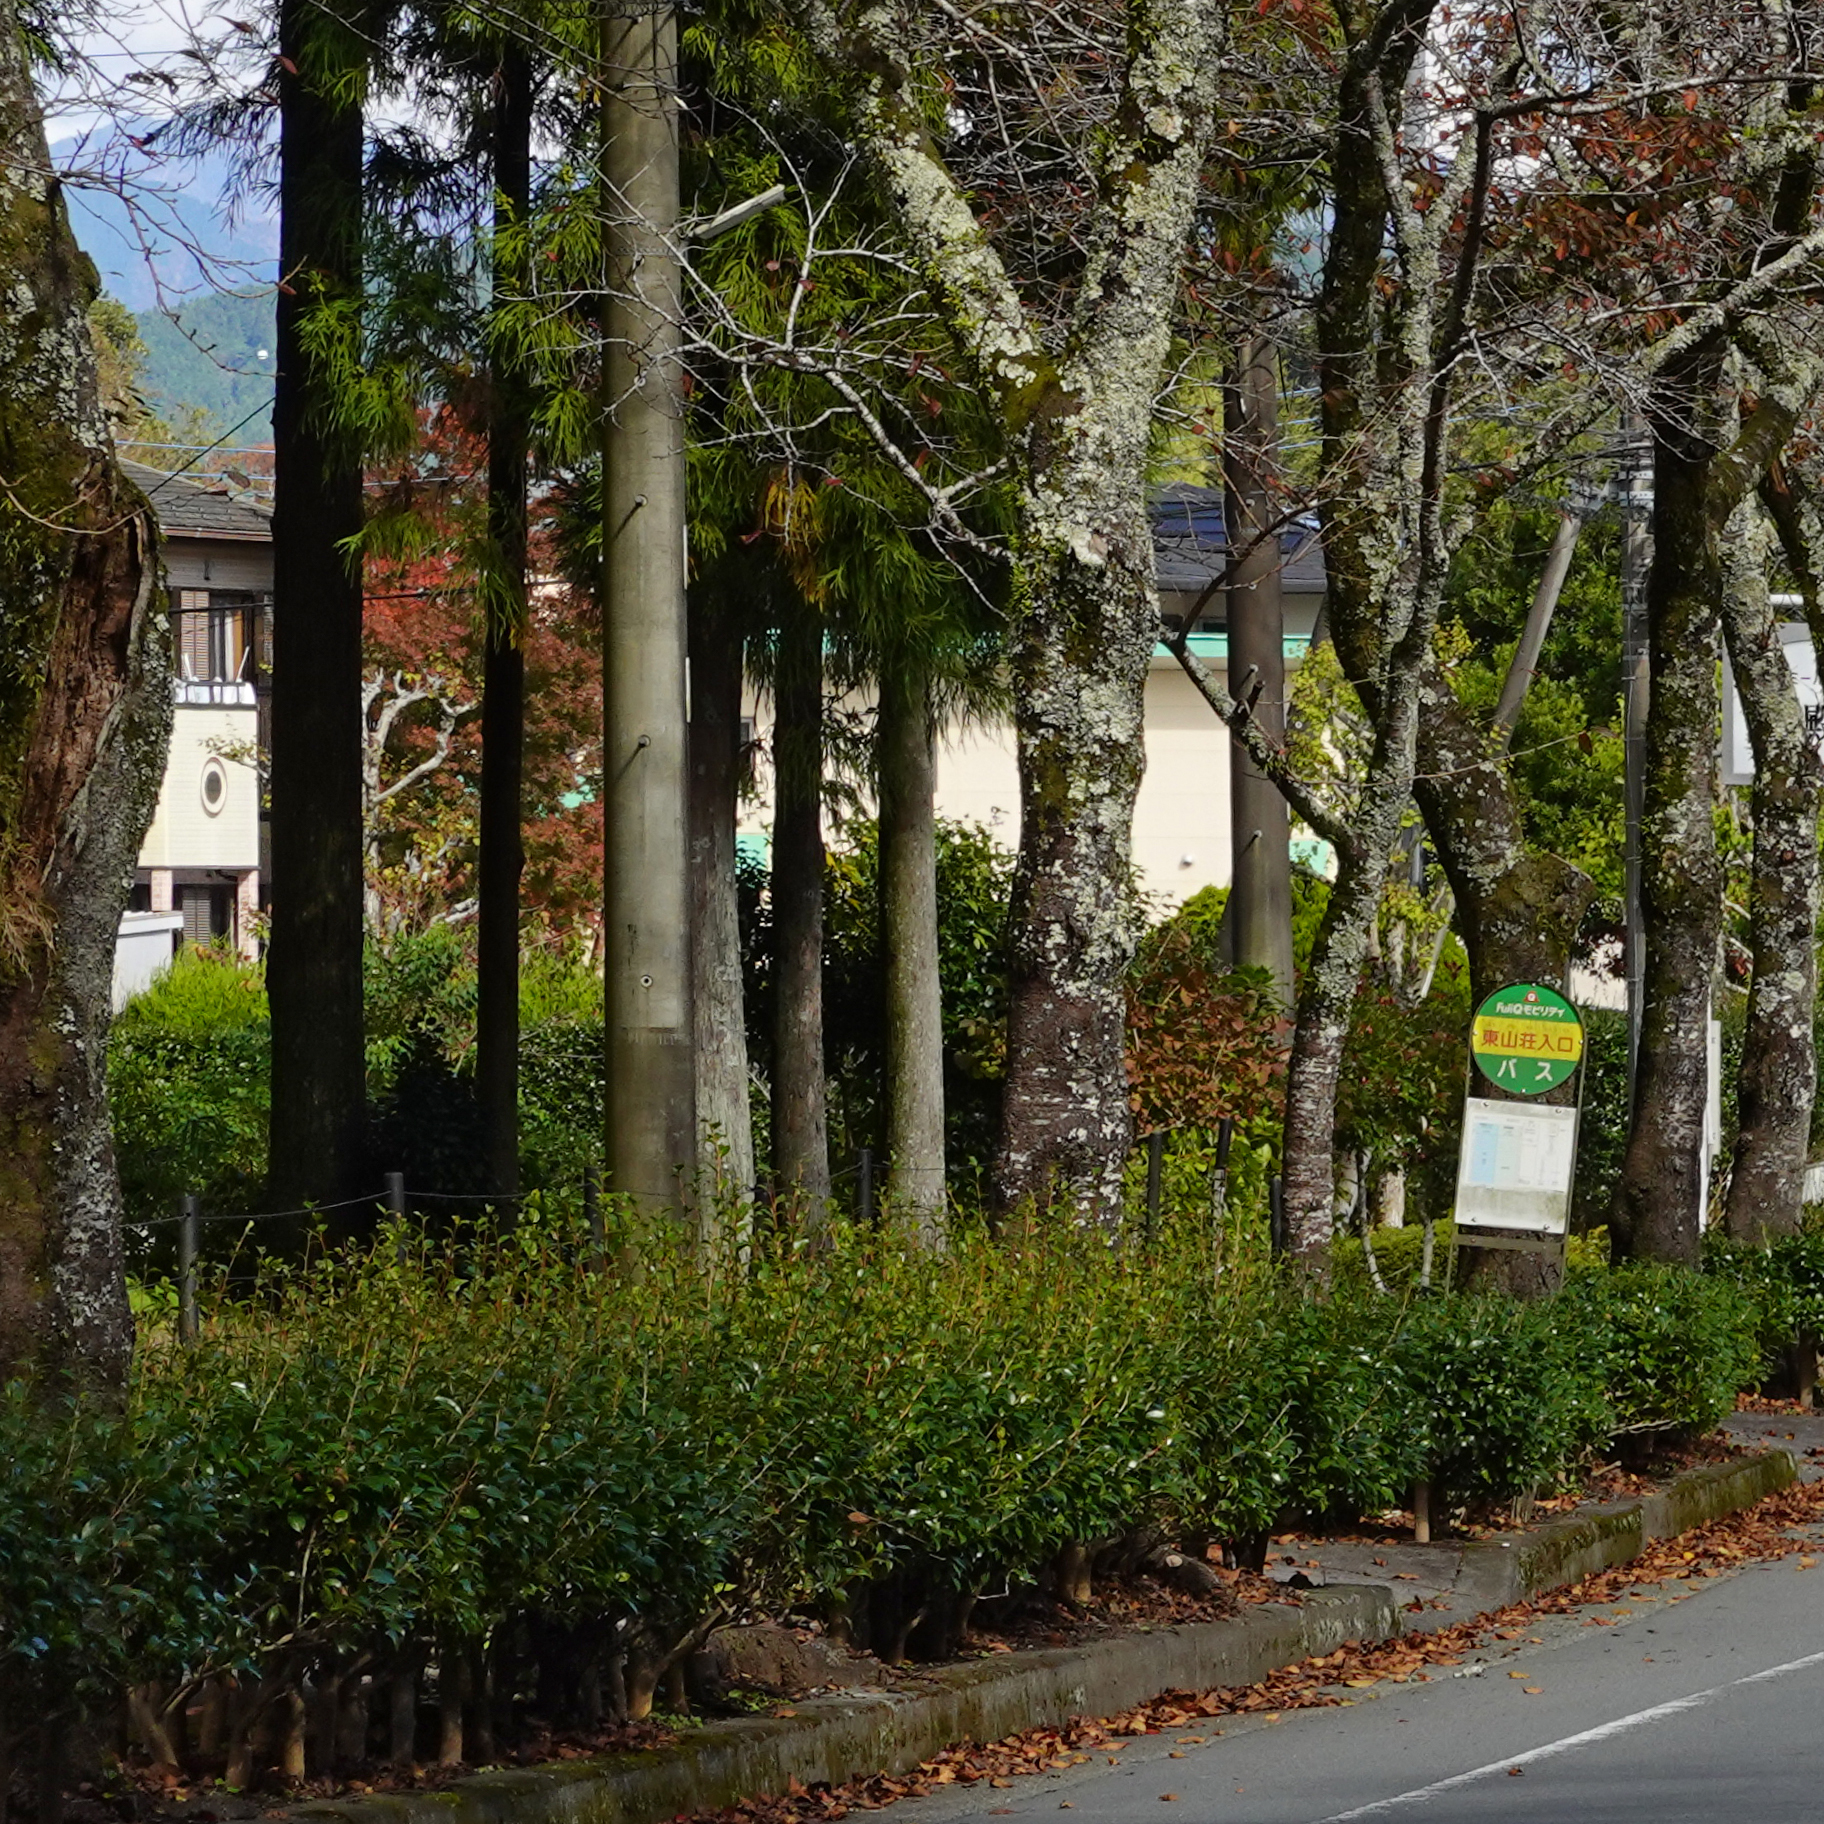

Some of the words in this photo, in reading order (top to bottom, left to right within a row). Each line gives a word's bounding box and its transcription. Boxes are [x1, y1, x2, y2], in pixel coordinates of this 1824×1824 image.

[1482, 1029, 1573, 1052] 東山荘入口
[1497, 1058, 1554, 1082] バス
